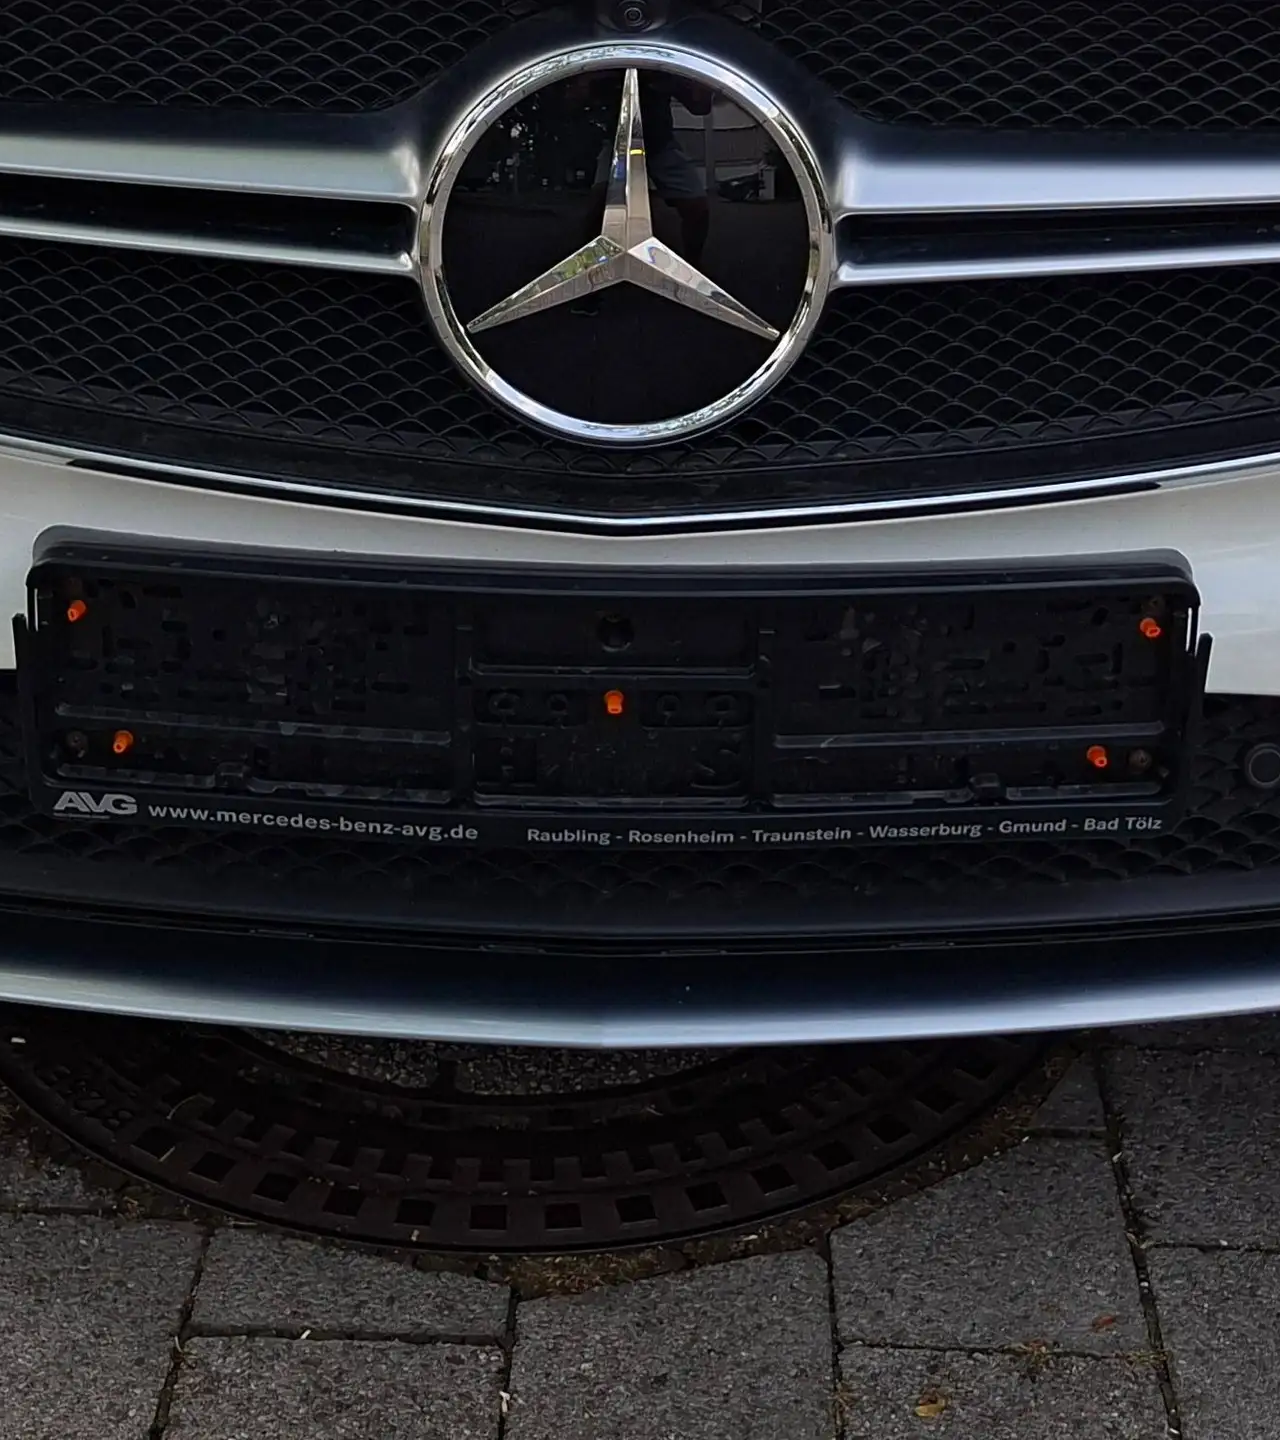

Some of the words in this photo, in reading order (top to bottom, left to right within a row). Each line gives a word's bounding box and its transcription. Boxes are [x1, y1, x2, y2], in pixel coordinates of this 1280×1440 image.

[53, 791, 138, 815] AVG
[147, 804, 479, 841] www.mercedes-benz-avg.de
[526, 828, 611, 845] Raubling
[627, 829, 734, 844] Rosenheim
[751, 826, 852, 843] Traunstein
[869, 823, 982, 839] Wasserburg
[998, 819, 1067, 834] Gmund
[1083, 817, 1120, 832] Bad
[1125, 816, 1163, 832] Tölz
